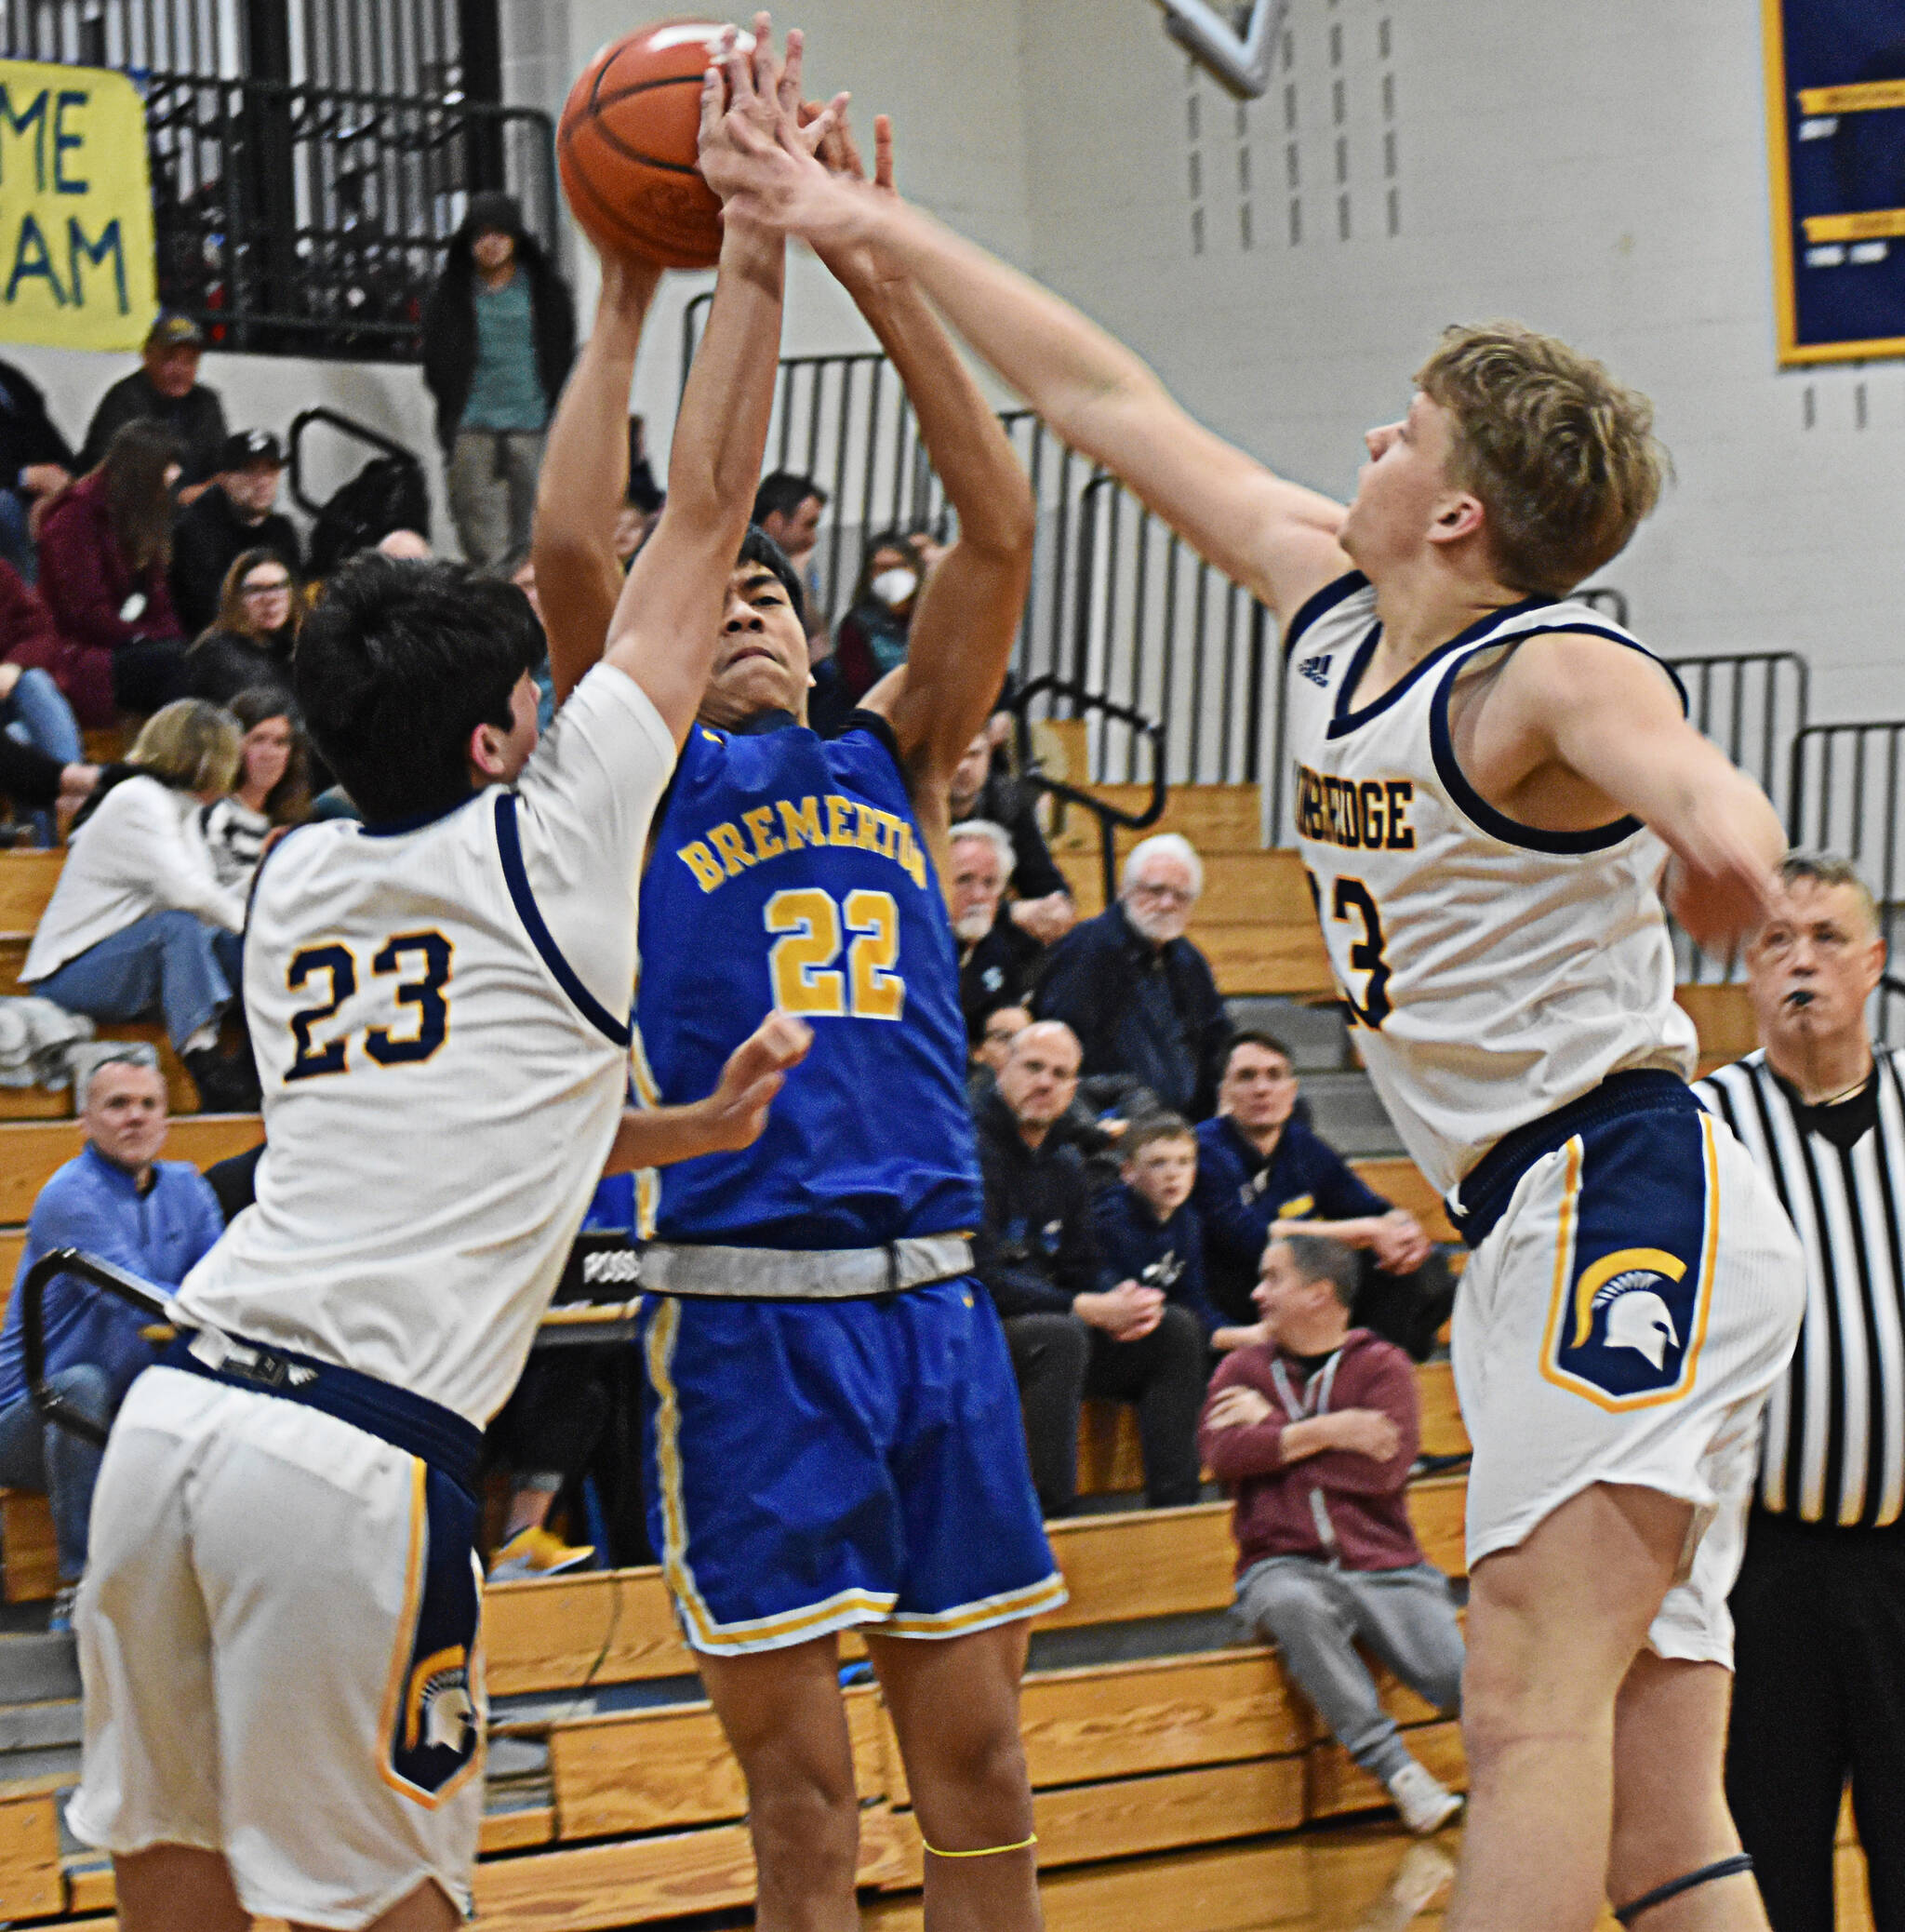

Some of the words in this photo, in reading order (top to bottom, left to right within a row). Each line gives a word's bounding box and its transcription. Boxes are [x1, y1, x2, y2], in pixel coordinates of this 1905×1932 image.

[6, 212, 130, 317] AM
[283, 926, 454, 1086] 23
[764, 887, 907, 1022] 22
[1306, 867, 1394, 1033] 3
